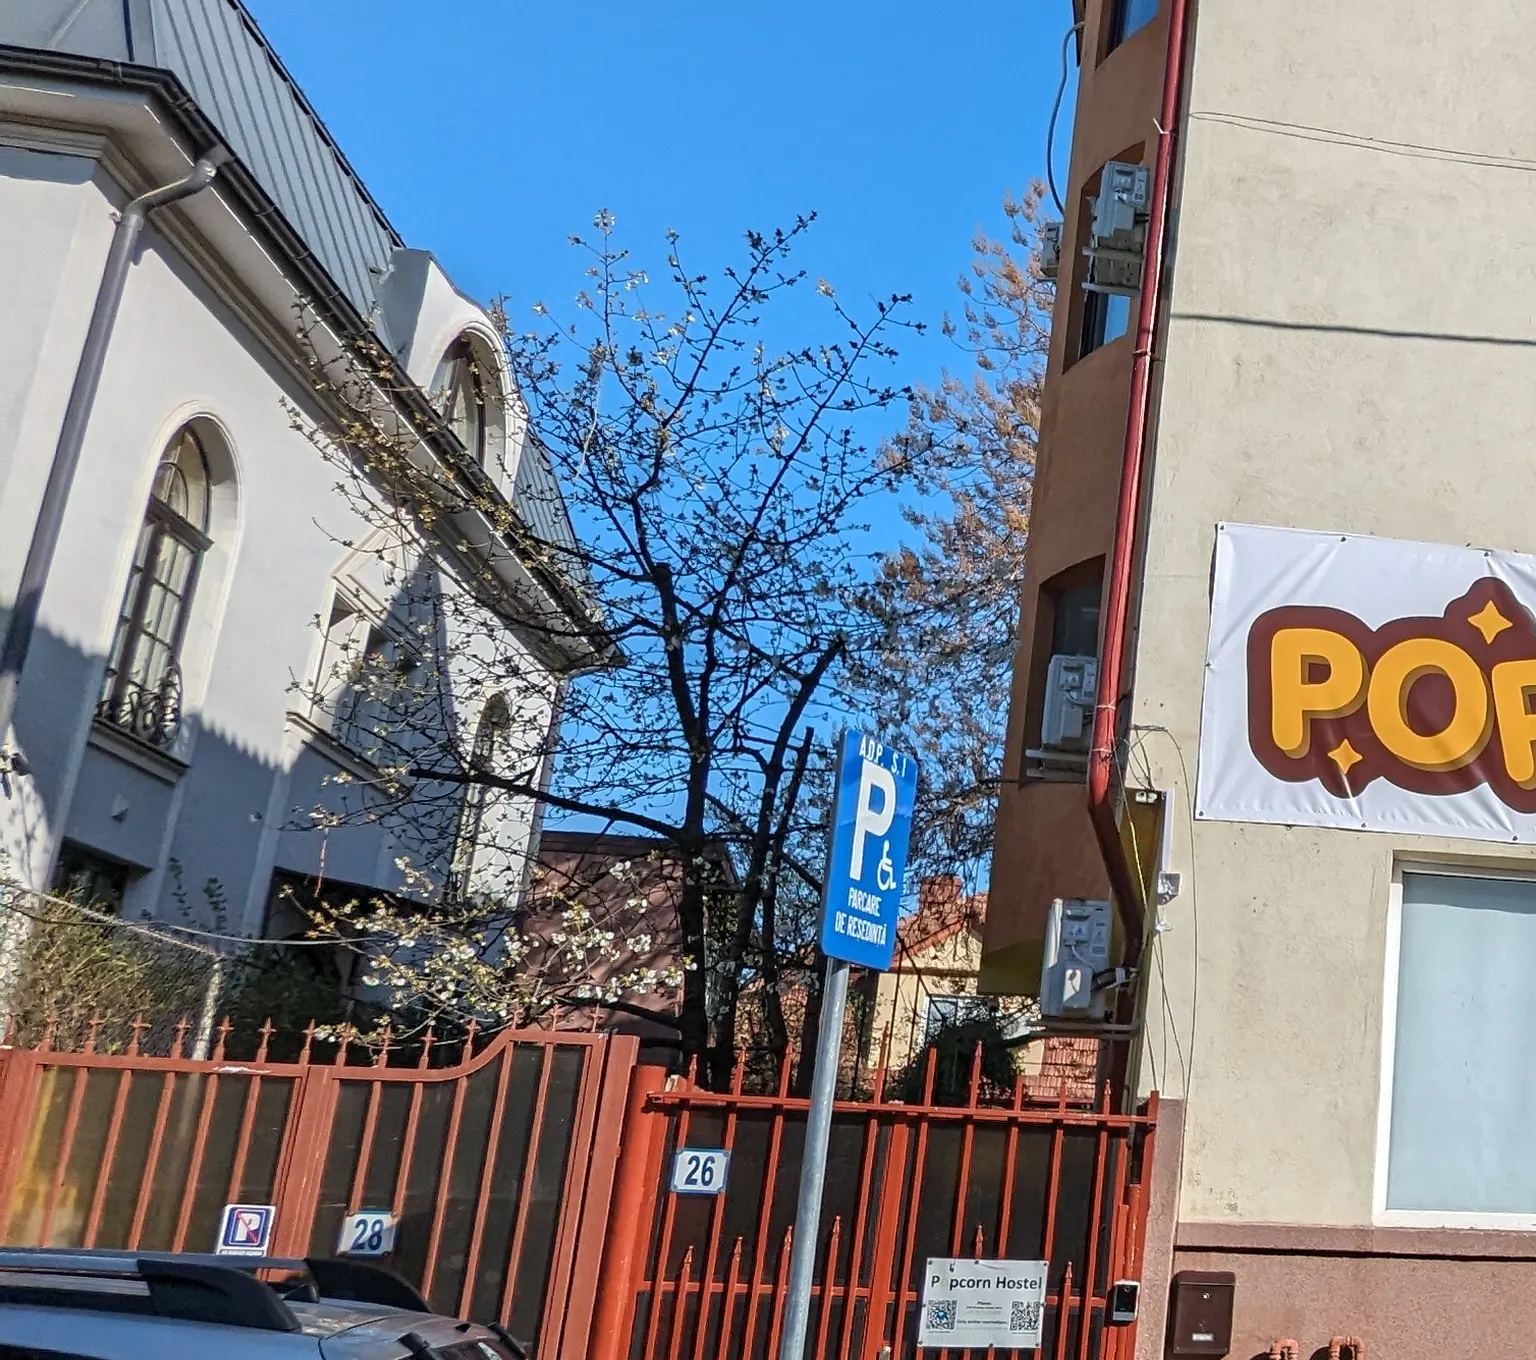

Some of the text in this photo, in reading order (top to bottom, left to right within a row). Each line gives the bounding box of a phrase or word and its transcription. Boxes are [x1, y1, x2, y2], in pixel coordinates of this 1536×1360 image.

[849, 759, 897, 881] P
[848, 886, 882, 918] PARCARE
[834, 910, 848, 934] DE
[684, 1155, 716, 1187] 26
[350, 1219, 384, 1251] 28
[995, 1276, 1042, 1290] Hostel
